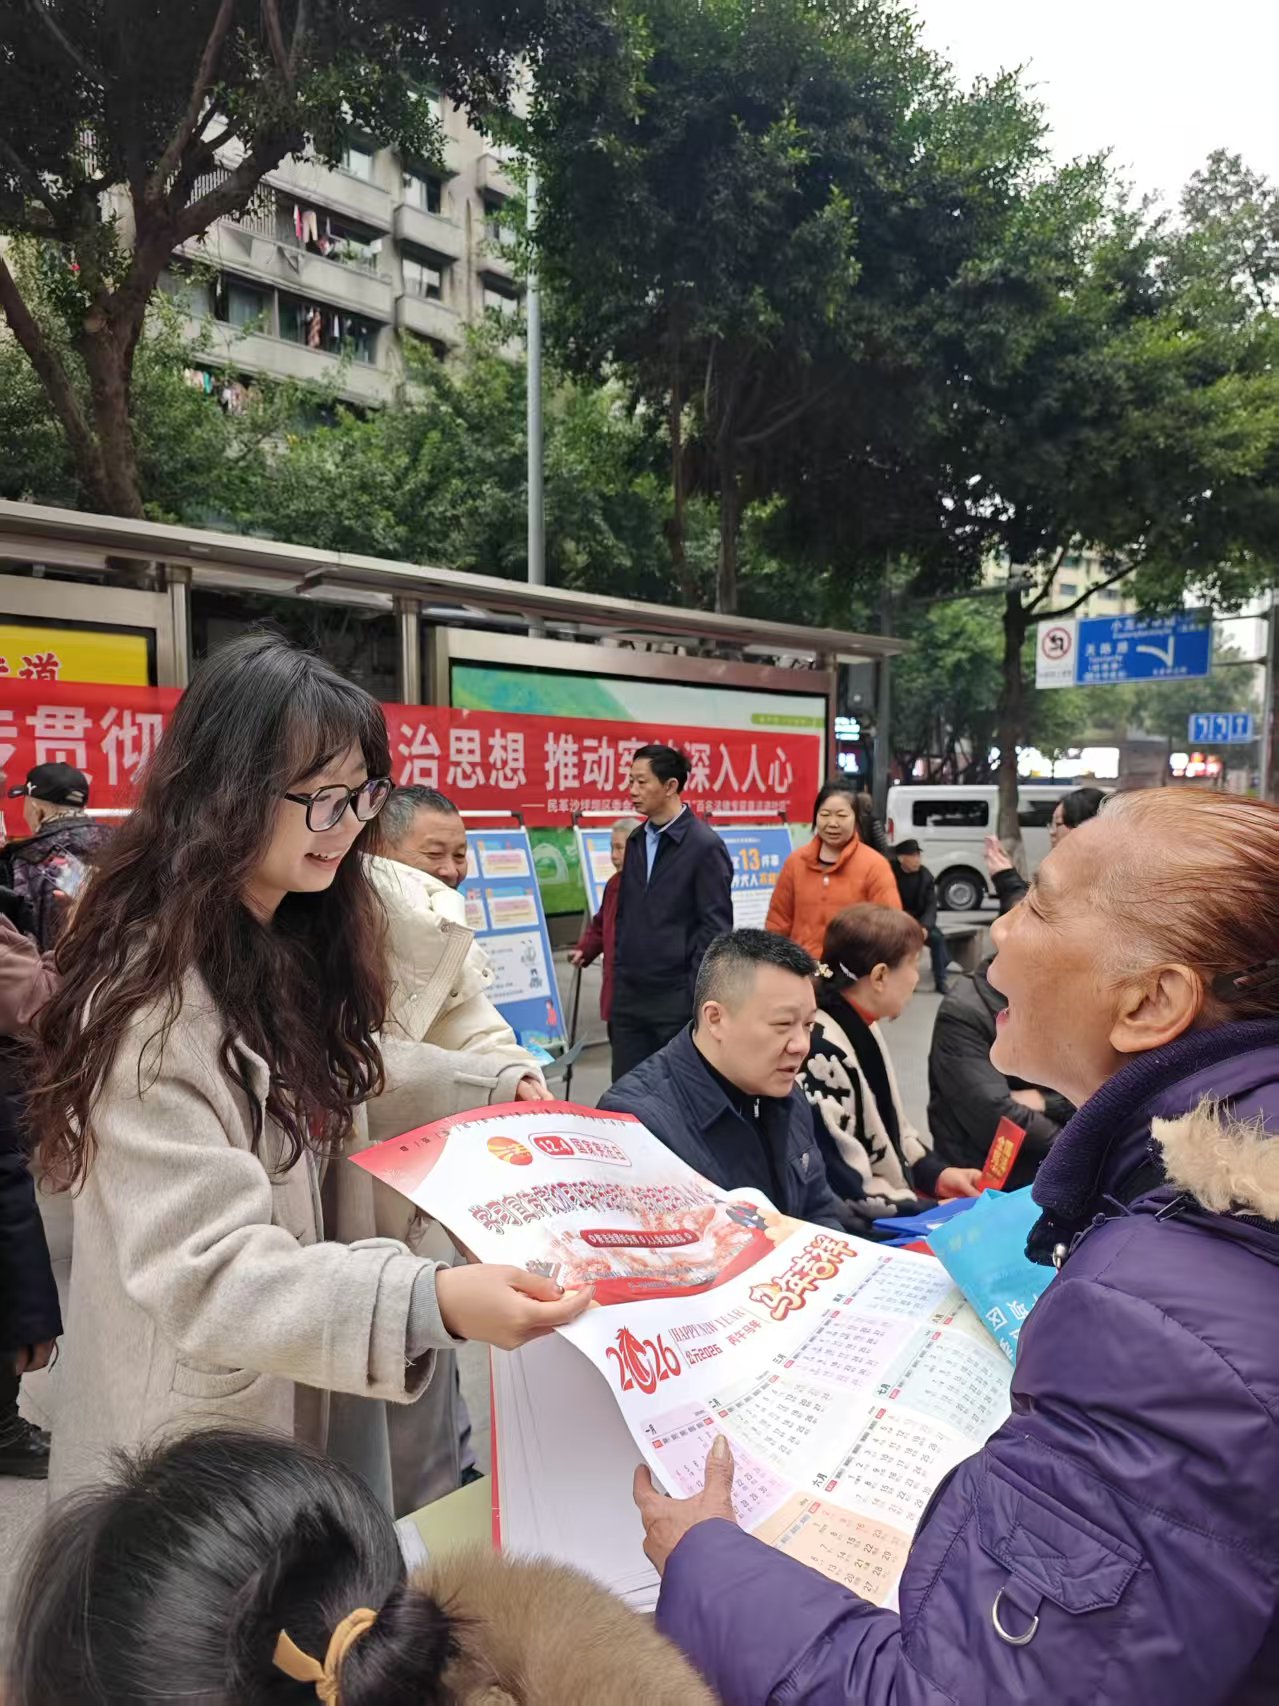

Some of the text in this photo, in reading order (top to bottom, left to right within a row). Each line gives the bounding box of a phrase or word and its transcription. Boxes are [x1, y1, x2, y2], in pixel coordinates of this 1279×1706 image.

[0, 653, 59, 681] 道
[544, 731, 793, 793] 推动宪深入人心
[749, 1233, 858, 1321] 马年吉祥
[671, 1323, 700, 1342] HAPPY
[714, 1308, 746, 1328] YEAR
[685, 1344, 723, 1365] 公元2026
[772, 1352, 786, 1365] 三月
[876, 1381, 891, 1396] 七月
[879, 1452, 890, 1462] 10
[887, 1440, 897, 1449] 11
[895, 1428, 905, 1437] 12
[811, 1471, 828, 1488] 六月
[855, 1460, 864, 1468] 2
[879, 1483, 889, 1493] 15
[887, 1470, 897, 1480] 16
[895, 1458, 905, 1467] 17
[903, 1446, 913, 1455] 18
[911, 1434, 921, 1443] 19
[895, 1489, 907, 1500] 22
[903, 1477, 914, 1487] 23
[912, 1464, 922, 1475] 24
[919, 1452, 931, 1463] 25
[921, 1485, 932, 1496] 30
[819, 1542, 828, 1550] 7
[826, 1562, 837, 1573] 13
[836, 1550, 847, 1560] 14
[845, 1535, 856, 1545] 15
[843, 1571, 856, 1584] 20
[853, 1557, 866, 1569] 21
[862, 1542, 874, 1553] 22
[862, 1549, 892, 1593] 27 28 29
